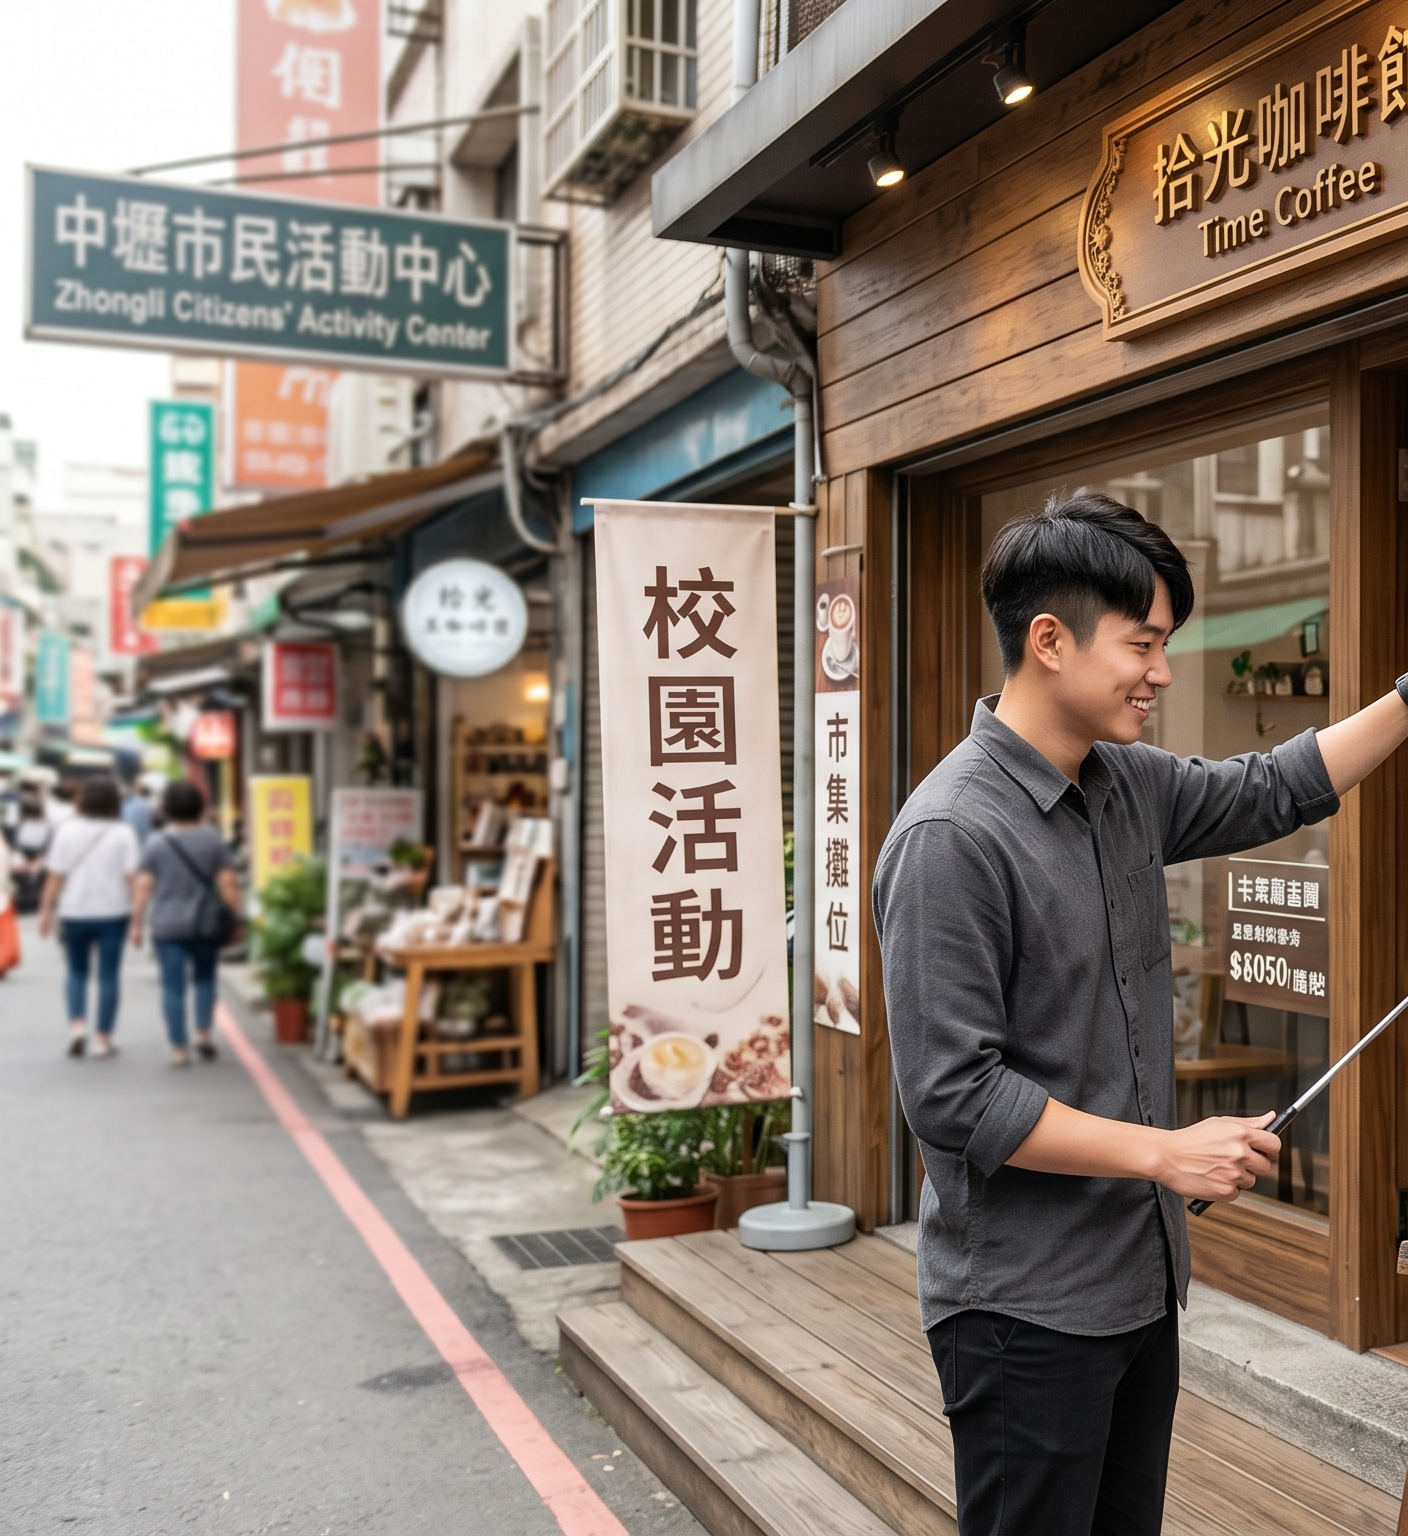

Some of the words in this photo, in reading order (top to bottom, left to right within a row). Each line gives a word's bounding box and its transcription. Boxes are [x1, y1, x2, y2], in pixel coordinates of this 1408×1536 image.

[55, 193, 491, 308] 中壢市民活動中心
[1198, 208, 1265, 256] Time
[1275, 161, 1377, 226] Coffee
[54, 278, 165, 324] Zhongli
[173, 291, 292, 331] Citizens'
[297, 304, 398, 348] Activity
[406, 315, 491, 351] Center
[642, 565, 743, 982] 校園活動
[826, 711, 849, 953] 市集攤位
